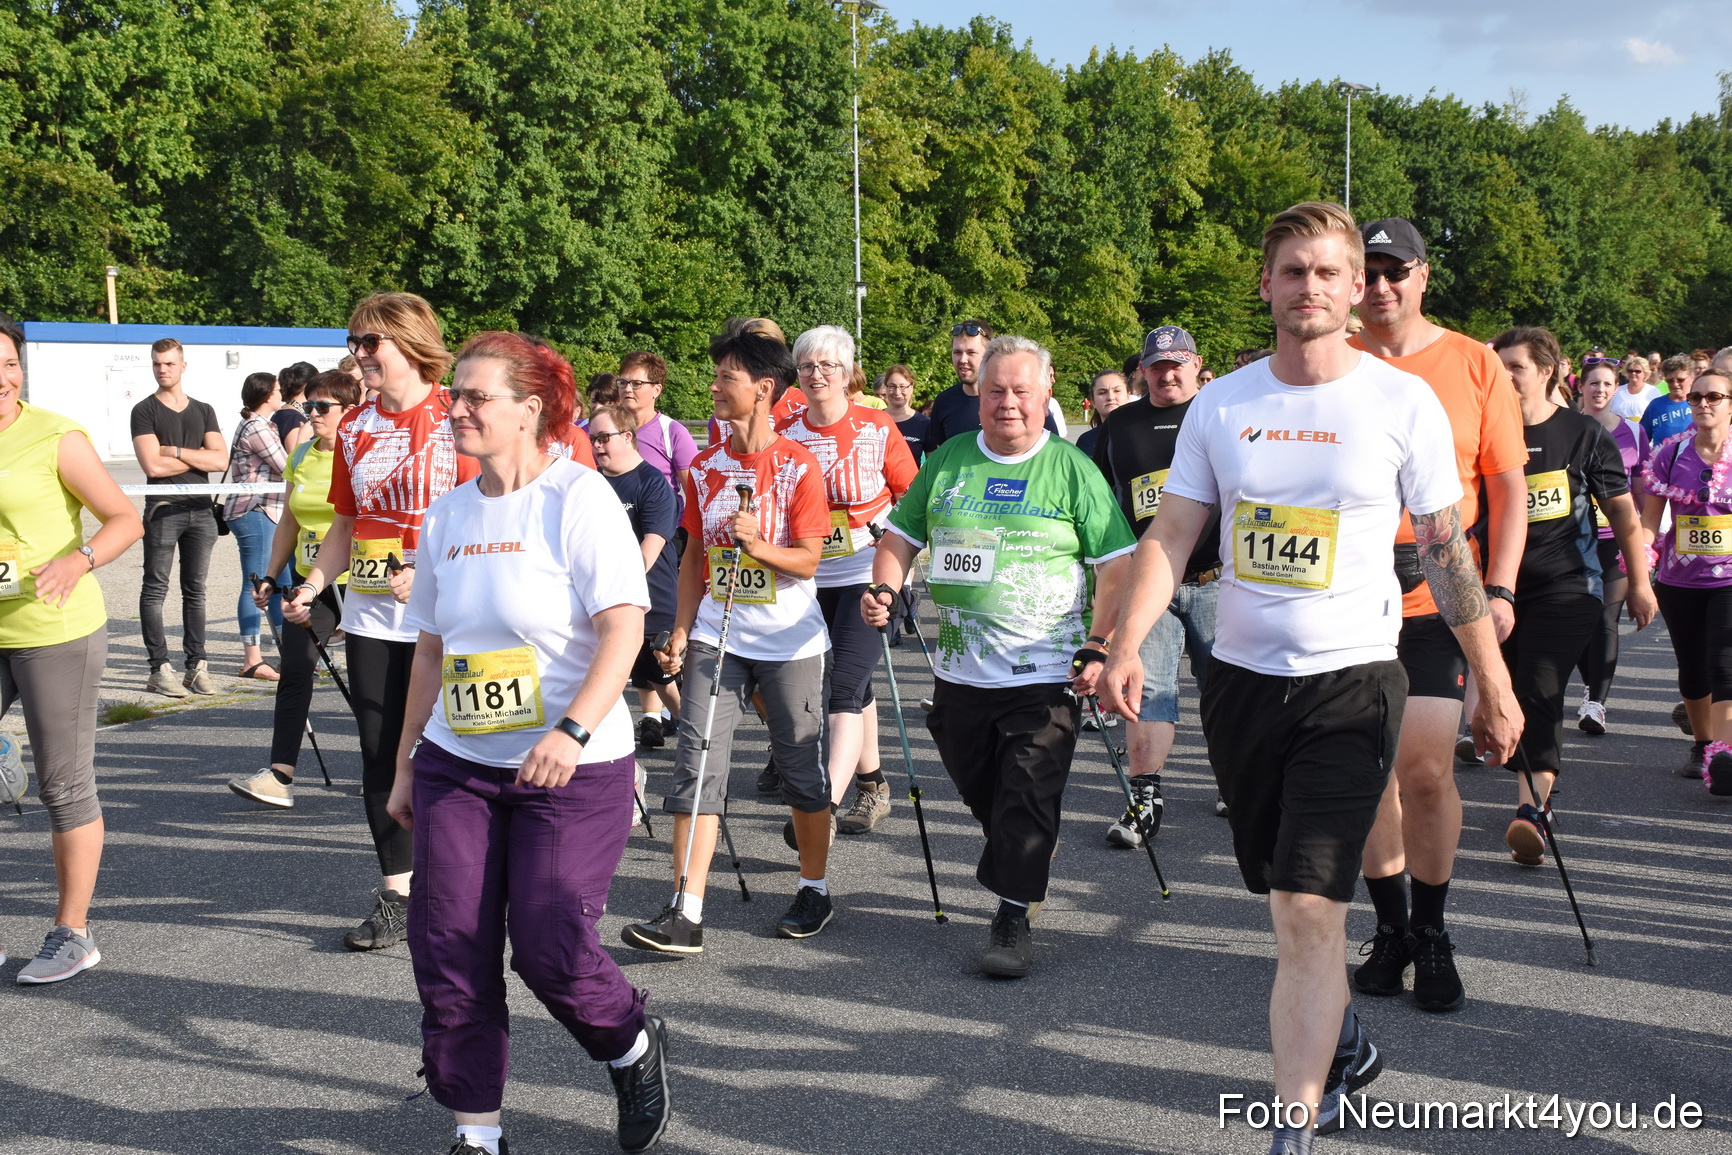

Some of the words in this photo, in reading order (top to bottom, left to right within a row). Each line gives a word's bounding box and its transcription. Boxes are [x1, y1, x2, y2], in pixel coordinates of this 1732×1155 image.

[1266, 430, 1342, 444] KLEBL
[994, 487, 1023, 495] Fischer
[960, 494, 1064, 519] firmenlauf
[957, 511, 1002, 521] neumarkt
[1247, 517, 1286, 528] firmenlauf
[994, 526, 1049, 538] Firmen
[1310, 529, 1331, 537] 2019
[1689, 530, 1722, 544] 886
[463, 541, 526, 556] KLEBL
[1001, 541, 1057, 557] länger!
[1244, 531, 1320, 565] 1144
[944, 553, 982, 573] 9069
[1252, 561, 1279, 570] Bastian
[1282, 564, 1307, 573] Wilma
[511, 669, 530, 677] 2019
[451, 678, 523, 712] 1181
[451, 713, 492, 721] Schaffrinski
[495, 708, 531, 717] Michaela
